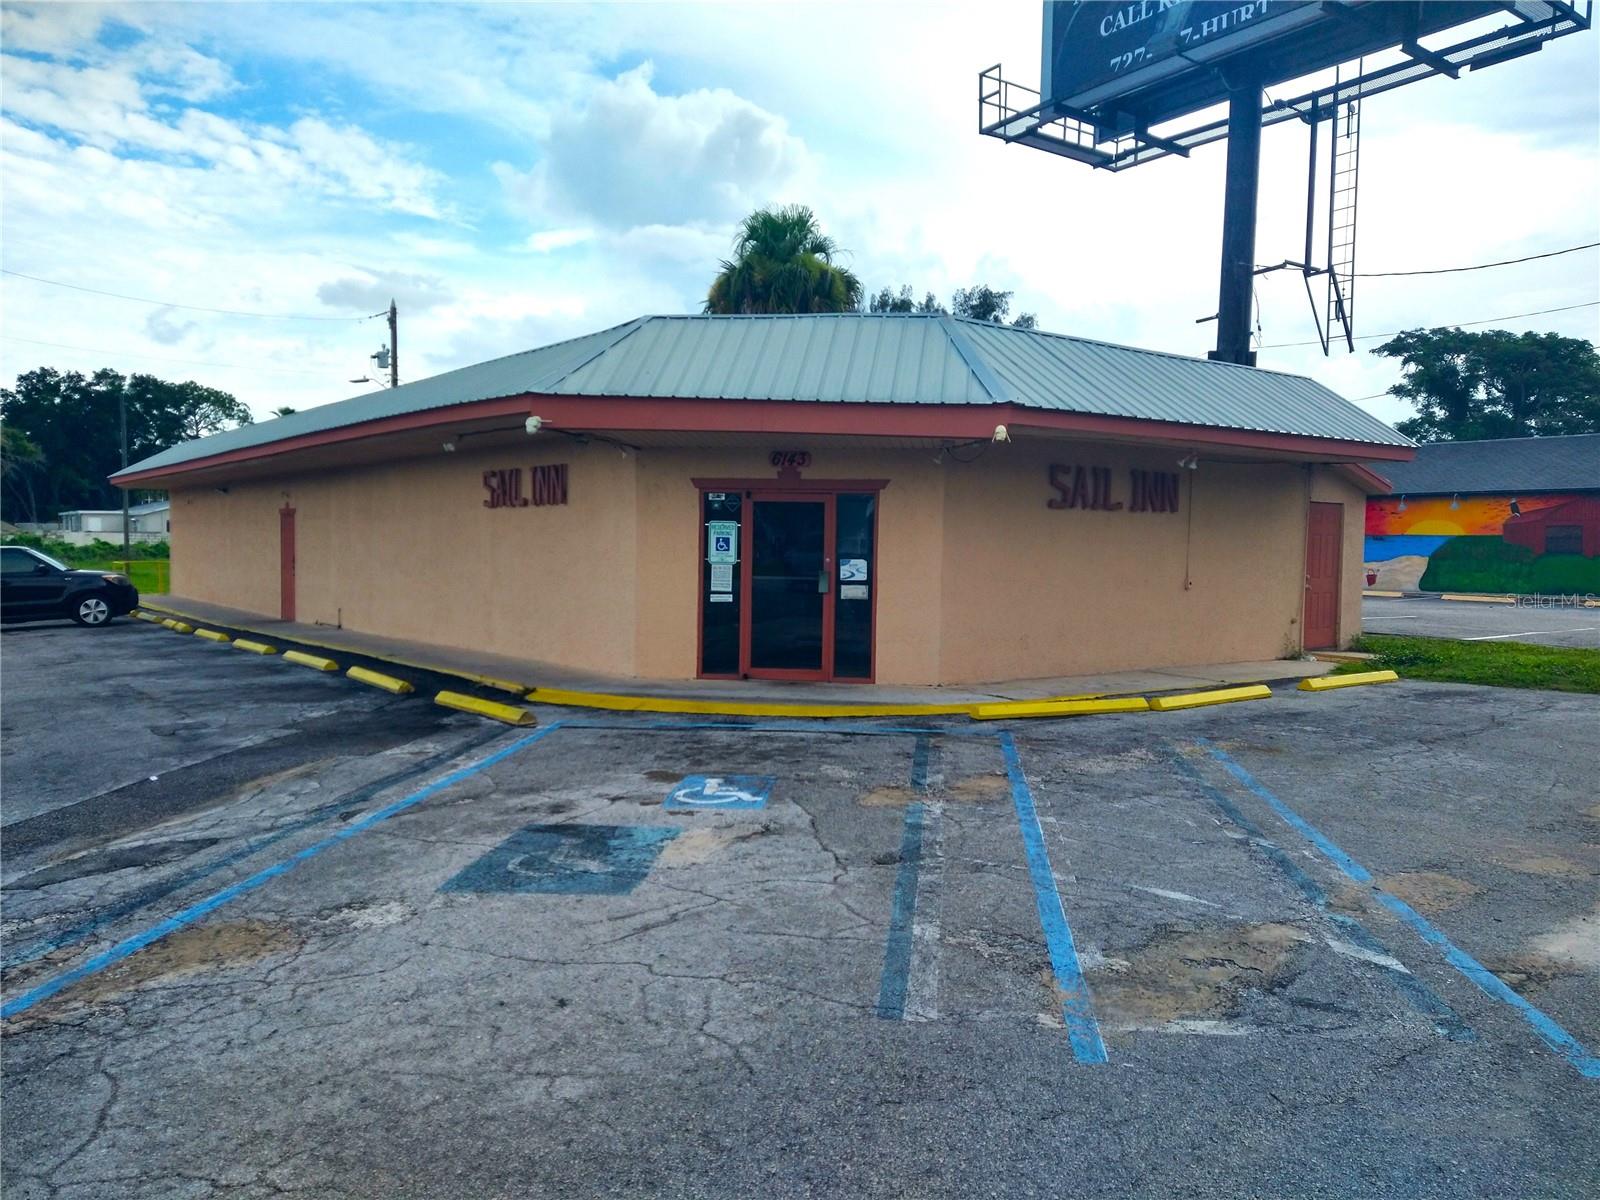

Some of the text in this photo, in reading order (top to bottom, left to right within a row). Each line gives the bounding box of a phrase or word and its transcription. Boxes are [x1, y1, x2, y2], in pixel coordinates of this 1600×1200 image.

[1100, 0, 1153, 37] CALL
[482, 463, 568, 509] SAIL INN
[1047, 463, 1179, 514] SAIL INN
